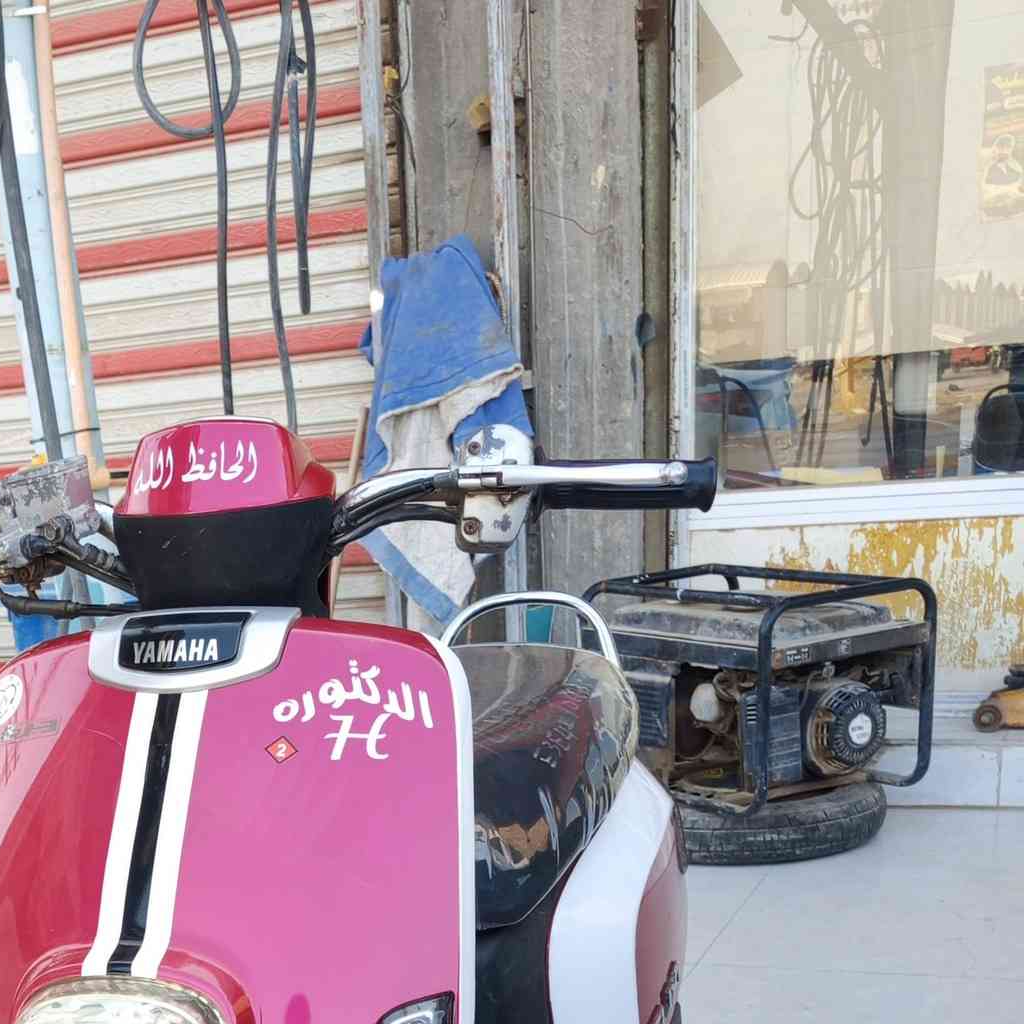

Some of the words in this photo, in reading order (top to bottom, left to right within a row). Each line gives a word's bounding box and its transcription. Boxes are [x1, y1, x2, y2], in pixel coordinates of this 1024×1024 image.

[133, 445, 175, 495] الله
[180, 439, 258, 484] الحافظ
[133, 638, 219, 665] YAMAHA
